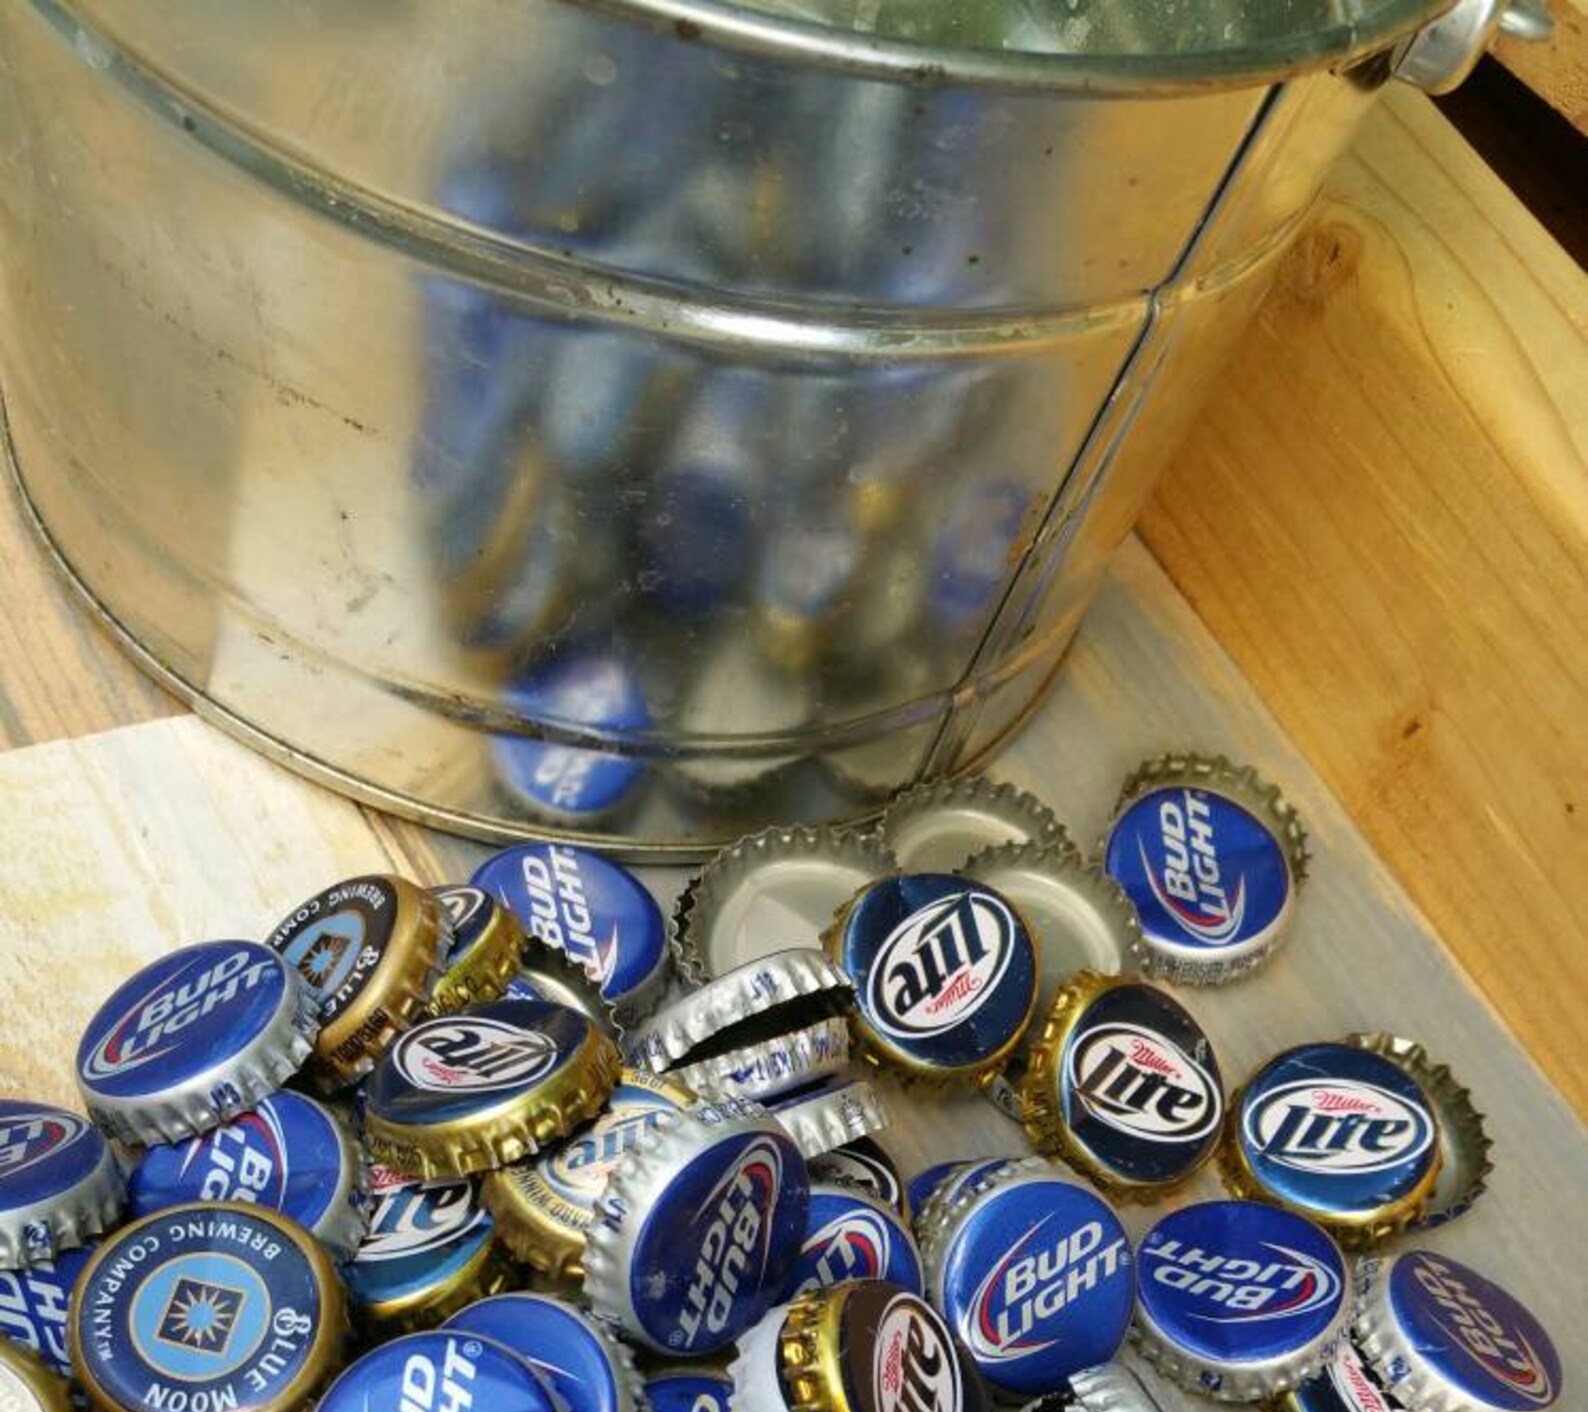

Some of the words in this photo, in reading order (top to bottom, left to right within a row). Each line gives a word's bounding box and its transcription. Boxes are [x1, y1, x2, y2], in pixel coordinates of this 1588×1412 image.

[1160, 801, 1199, 902] BUD
[1185, 790, 1233, 920] LIGHT
[270, 901, 322, 948] COMP
[329, 883, 387, 909] BREWING
[522, 855, 562, 950] BUD
[549, 845, 601, 977] LIGHT
[139, 951, 250, 1031] BUD
[326, 945, 380, 1018] BLUE
[888, 895, 990, 1017] Lite
[929, 972, 983, 1015] Miller
[120, 958, 276, 1065] LIGHT
[417, 1029, 550, 1079] Lite
[1076, 1048, 1203, 1122] Lite
[1127, 1039, 1176, 1076] Miller
[1262, 1104, 1409, 1159] Lite
[1313, 1090, 1376, 1113] Miller
[201, 1126, 246, 1201] LIG
[169, 1221, 282, 1261] BREWING
[679, 1171, 753, 1348] LIGHT
[707, 1202, 762, 1334] BUD
[1004, 1221, 1103, 1307] BUD
[1143, 1237, 1310, 1292] LIGHT
[93, 1236, 161, 1339] COMPANY
[997, 1238, 1127, 1350] LIGHT
[1153, 1266, 1280, 1312] BUD
[1413, 1267, 1501, 1356] BUD
[1420, 1253, 1530, 1370] LIGHT
[245, 1306, 312, 1393] BLUE
